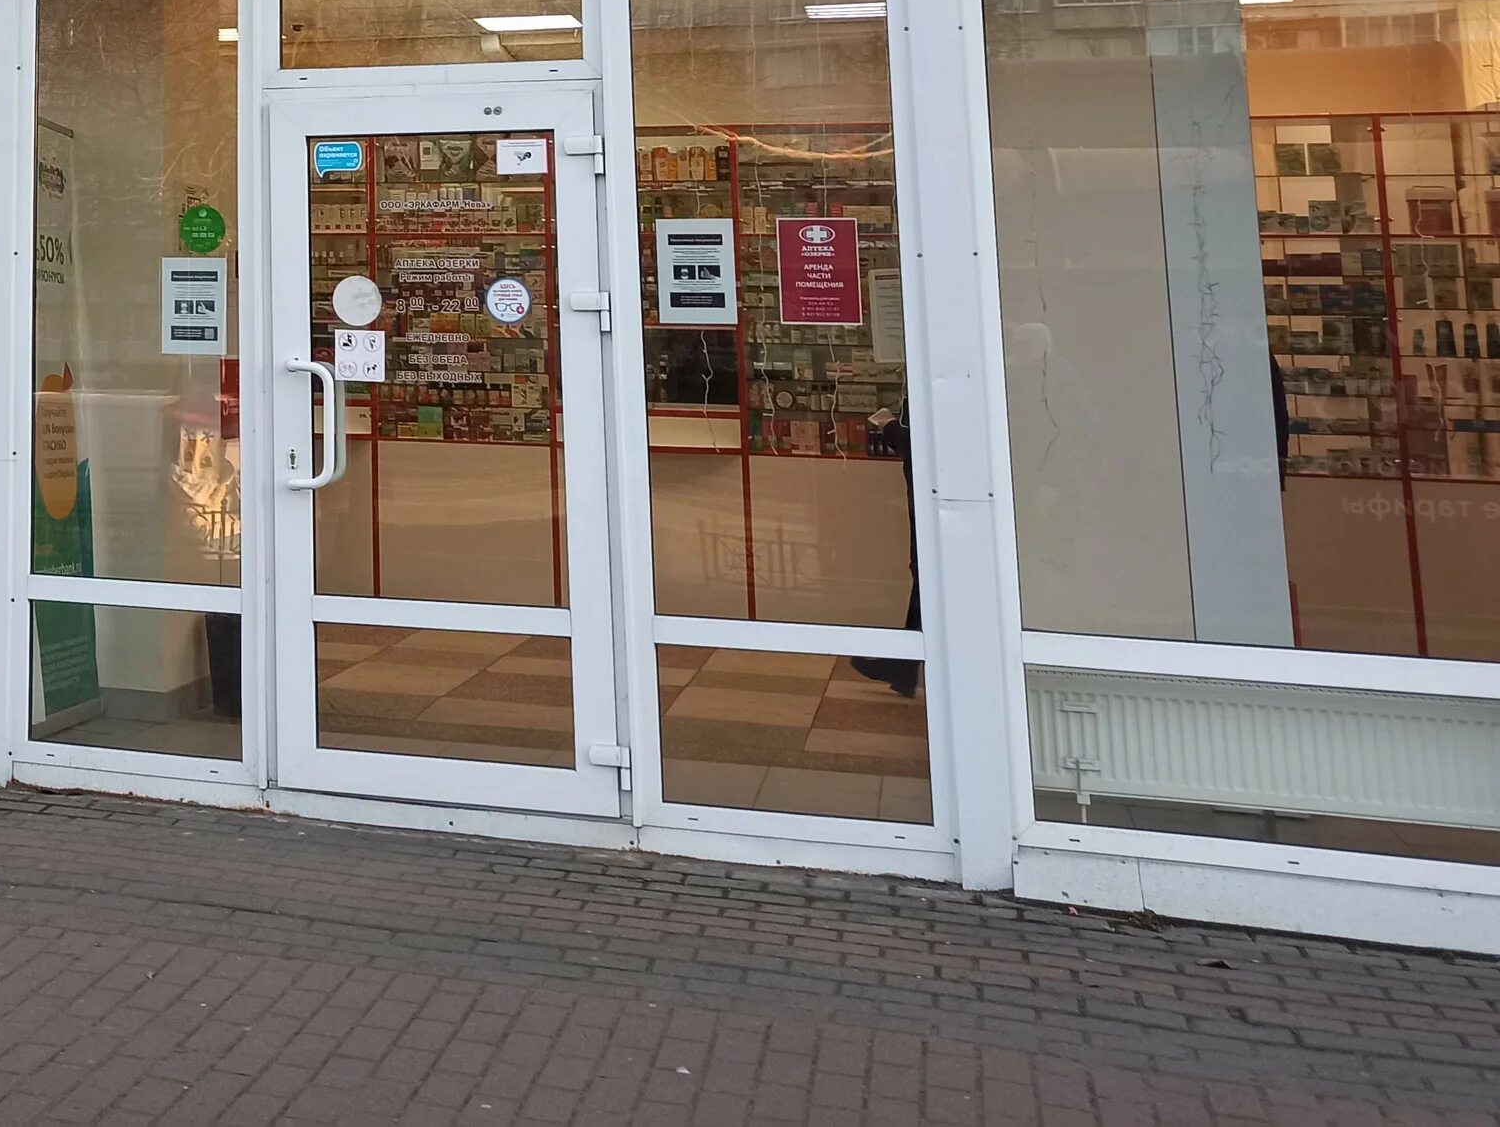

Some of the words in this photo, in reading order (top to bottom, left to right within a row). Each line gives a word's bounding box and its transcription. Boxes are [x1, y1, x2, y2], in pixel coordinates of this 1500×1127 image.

[380, 200, 401, 209] ООО
[40, 235, 64, 265] 50%
[395, 259, 437, 269] АПТЕКА
[438, 259, 480, 269] ОЗЕРКИ
[804, 263, 834, 271] АРЕНДА
[400, 273, 432, 282] Режим
[795, 281, 844, 289] ПОМЕЩЕНИЯ
[396, 299, 406, 312] 8
[410, 297, 424, 310] 00
[442, 299, 461, 312] 22
[464, 297, 479, 310] 00
[406, 333, 470, 343] ЕЖЕДНЕВНО
[409, 354, 429, 364] БЕЗ
[431, 354, 468, 364] ОБЕДА
[396, 371, 417, 381] БЕЗ
[419, 371, 482, 383] ВЫХОДНЫХ
